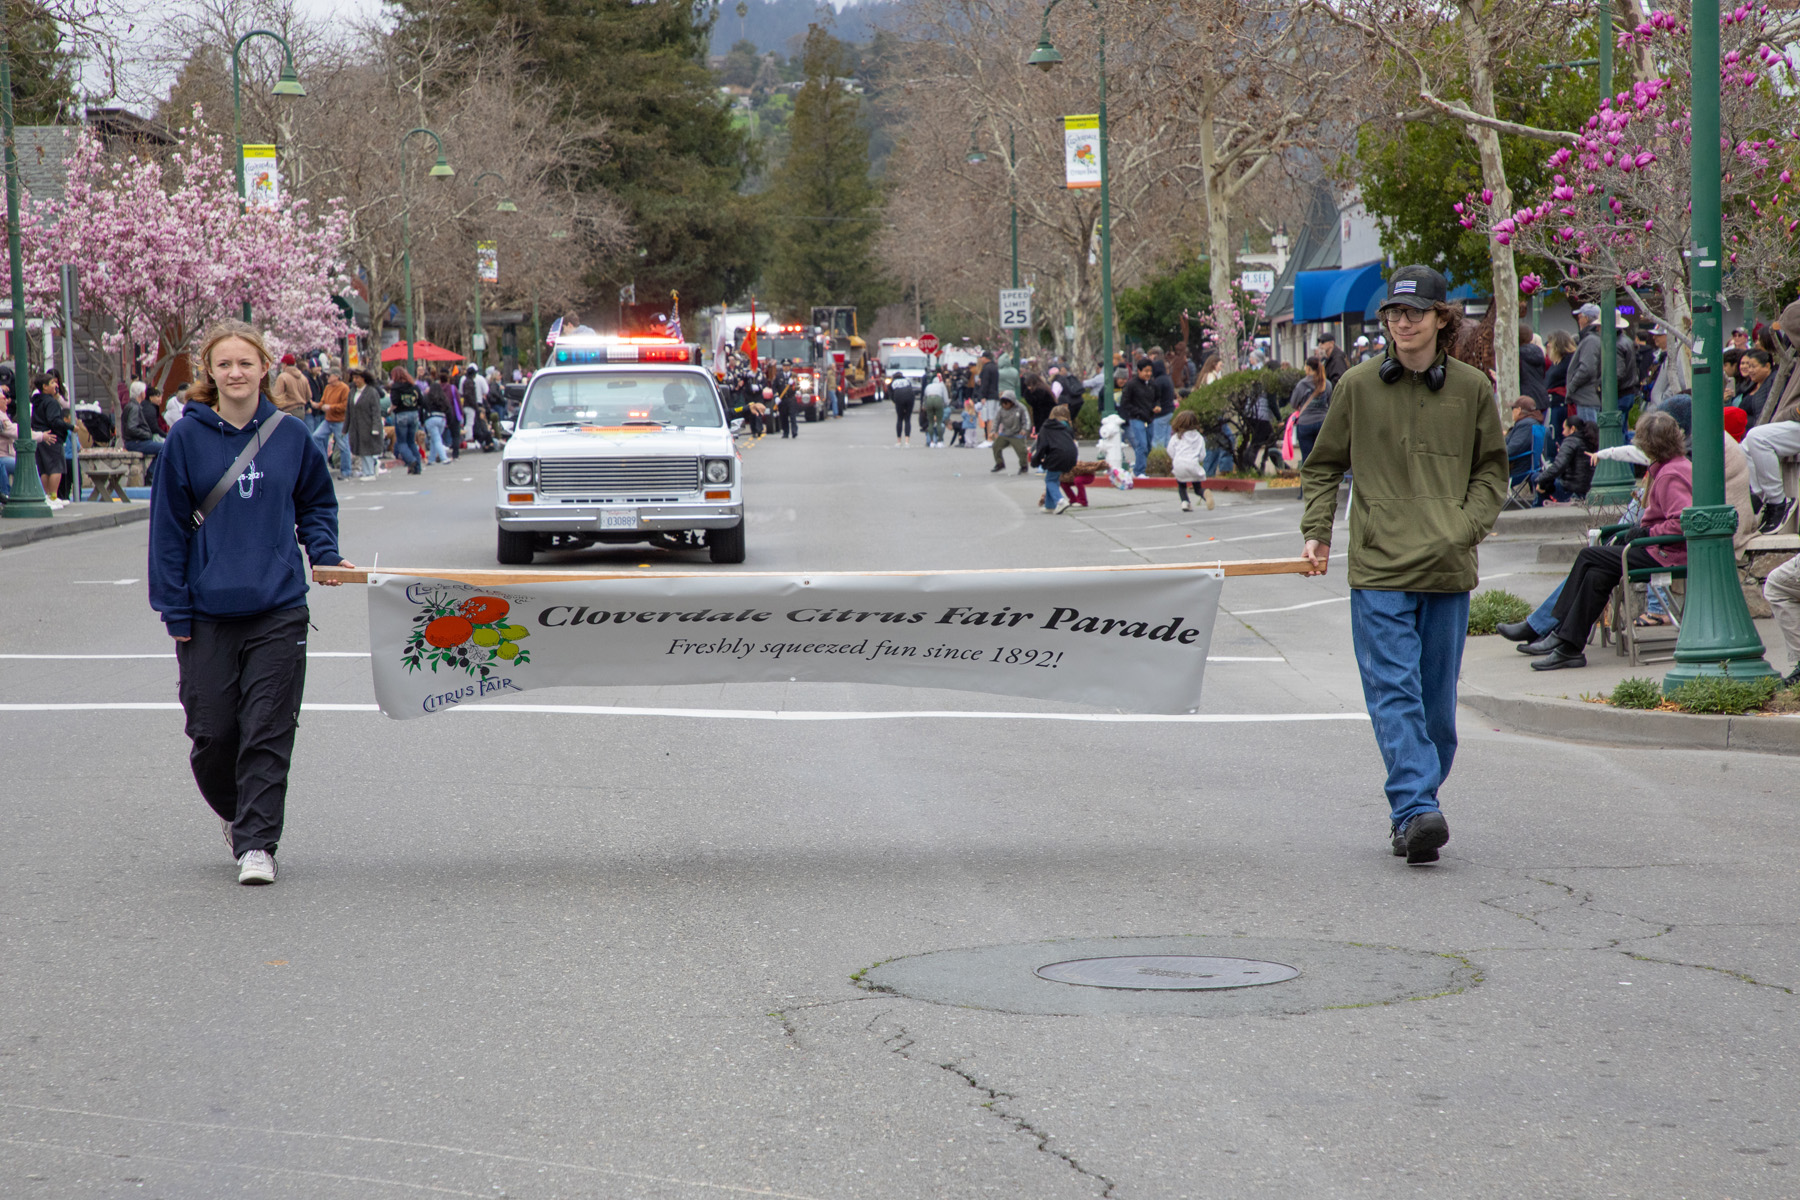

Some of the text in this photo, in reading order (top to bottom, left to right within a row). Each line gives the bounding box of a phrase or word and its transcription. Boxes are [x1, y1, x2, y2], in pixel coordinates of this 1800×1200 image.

[1002, 292, 1029, 300] SPEED
[1004, 310, 1027, 324] 25
[919, 339, 938, 349] STOP
[608, 516, 637, 527] 030889
[537, 605, 1200, 645] Cloverdale Citrus Fair Parade
[665, 637, 1065, 669] Freshly squeezed fun since 1892!
[422, 676, 523, 713] CITRUS FAIR
